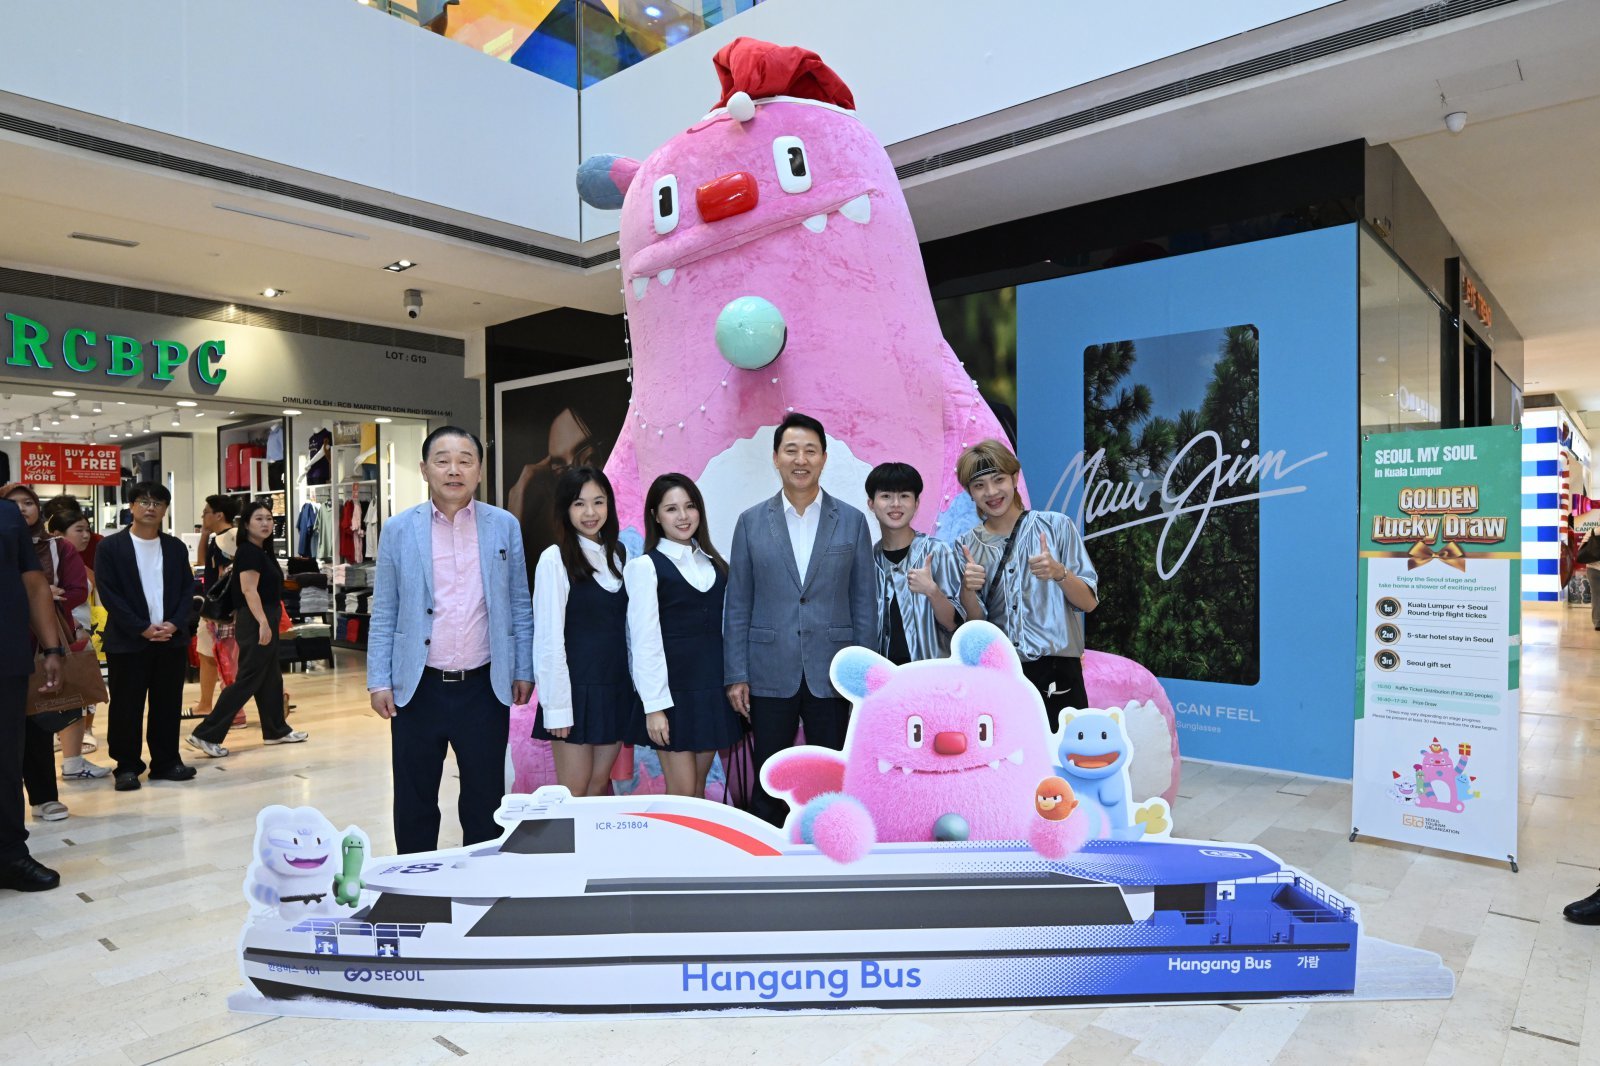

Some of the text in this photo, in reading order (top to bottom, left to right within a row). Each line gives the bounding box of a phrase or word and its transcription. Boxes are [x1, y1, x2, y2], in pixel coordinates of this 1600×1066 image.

[5, 312, 227, 385] RCBPC
[385, 351, 404, 360] LOT
[411, 355, 427, 364] G13
[282, 396, 312, 405] DIMILIKI
[313, 399, 333, 407] OLEH
[65, 449, 116, 458] BUY 4 GET
[1375, 444, 1478, 464] SEOUL MY SOUL
[66, 457, 117, 470] 1 FREE
[24, 474, 56, 482] MORE
[1384, 467, 1408, 477] Kuala
[1410, 466, 1443, 478] Lumpur
[1045, 430, 1328, 580] Maui Jim
[1399, 486, 1478, 512] GOLDEN
[1373, 515, 1506, 541] Lucky Draw
[1428, 602, 1454, 610] Lumpur
[1408, 610, 1445, 618] Round-trip
[1382, 657, 1392, 665] 3rd
[1176, 702, 1261, 722] CAN FEEL
[1176, 721, 1221, 733] Sunglasses
[596, 821, 648, 830] ICR-251804
[1168, 956, 1272, 974] Hangang Bus
[1297, 955, 1320, 969] 가람
[304, 966, 320, 975] 101
[375, 970, 424, 981] SEOUL
[682, 960, 922, 999] Hangang Bus
